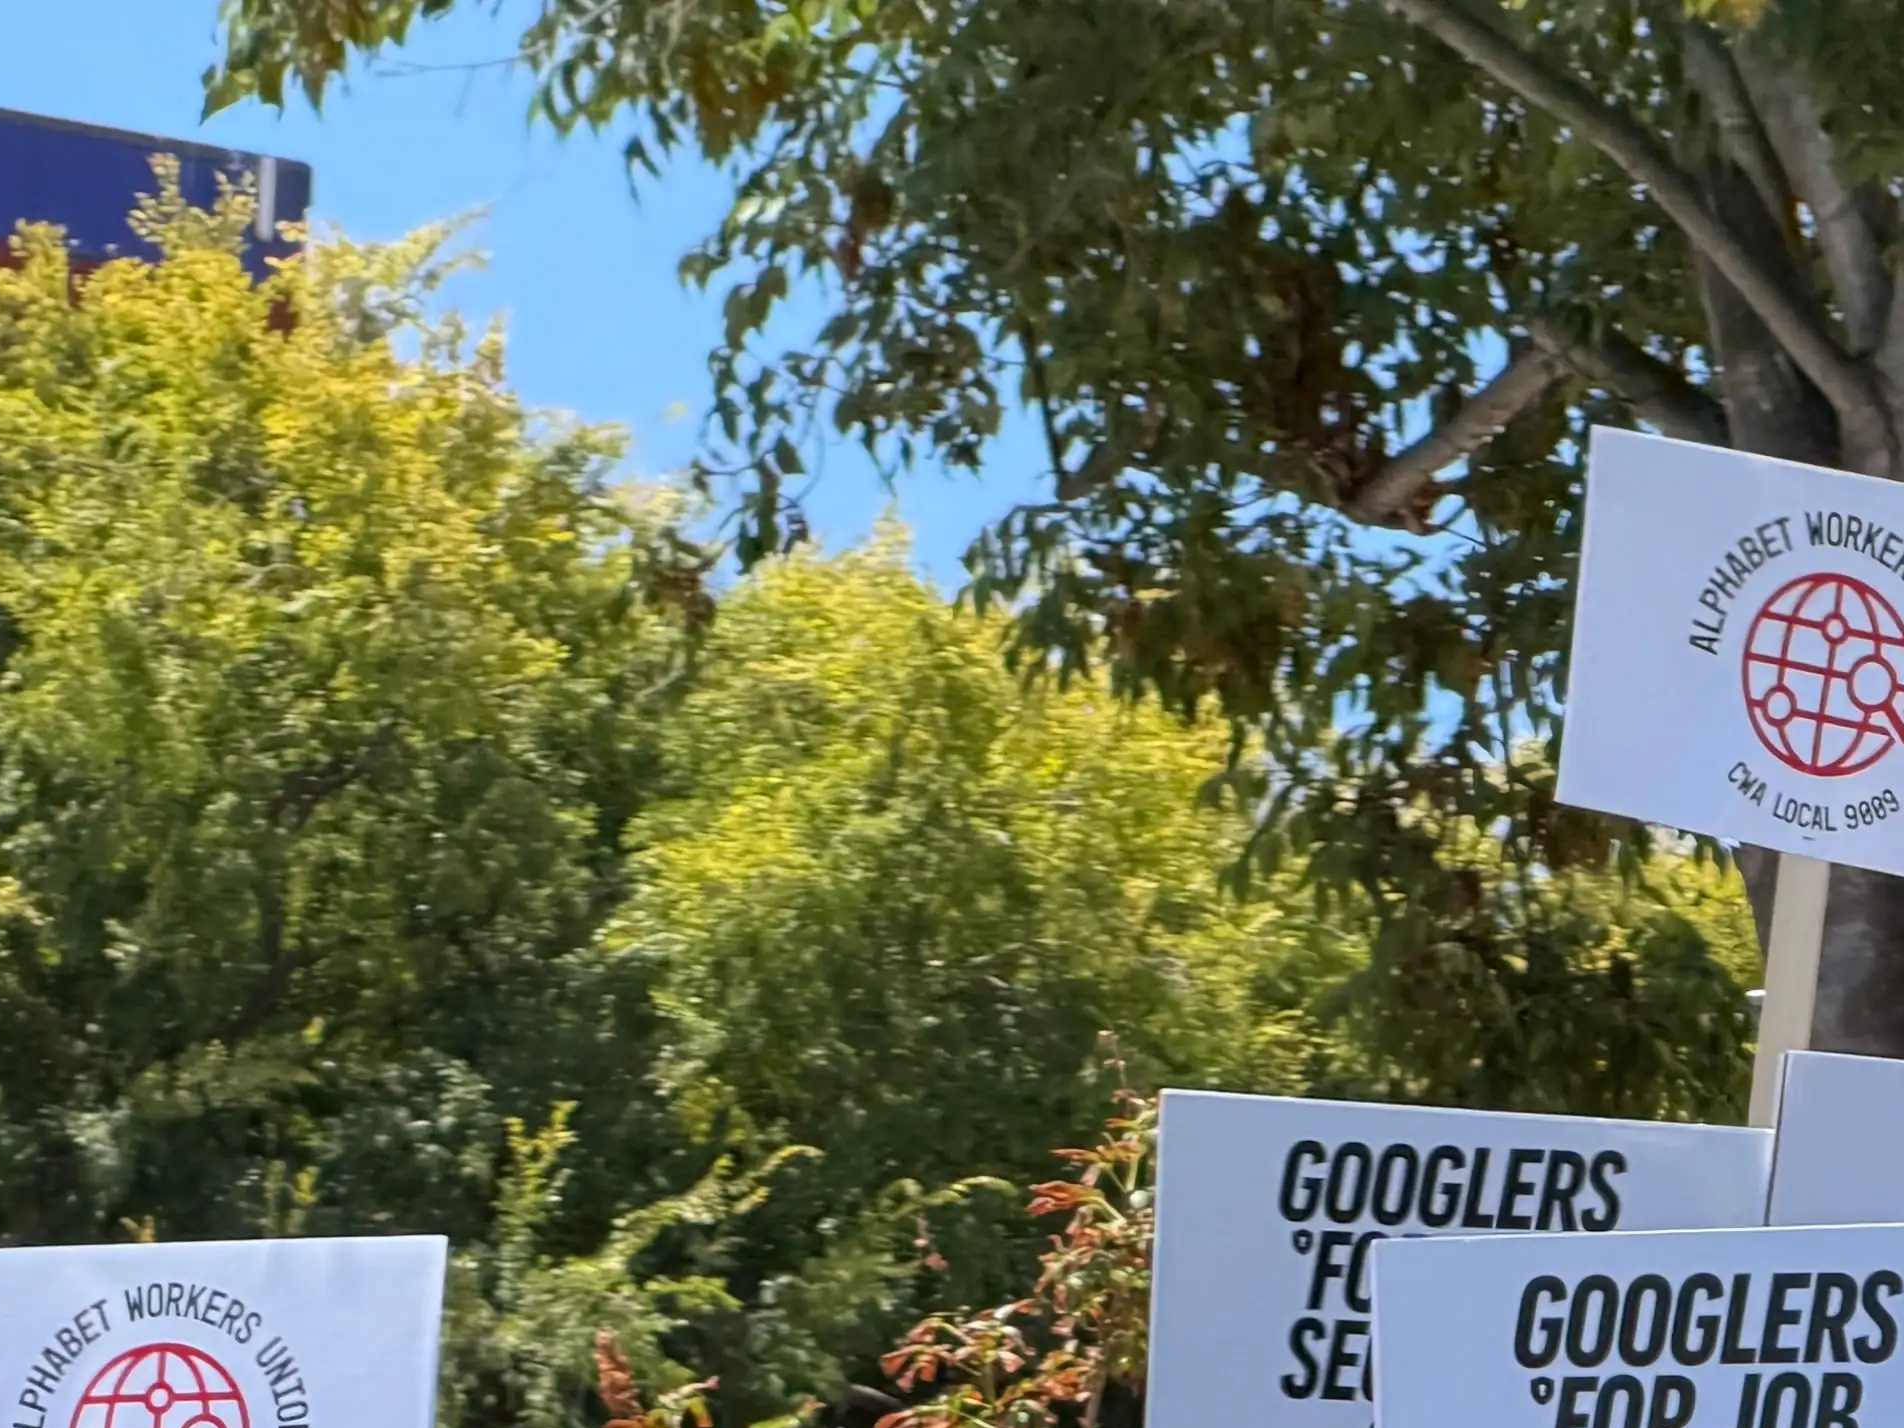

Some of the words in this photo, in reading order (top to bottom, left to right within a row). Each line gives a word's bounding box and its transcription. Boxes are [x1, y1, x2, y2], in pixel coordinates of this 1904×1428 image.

[1689, 516, 1793, 655] ALPHABET
[1726, 761, 1764, 807] CWA
[1773, 791, 1837, 832] LOCAL
[1845, 788, 1901, 829] 9009
[1279, 1139, 1627, 1232] GOOGLERS
[123, 1282, 262, 1341] WORKERS
[1306, 1231, 1386, 1313] FO
[1514, 1270, 1904, 1368] GOOGLERS
